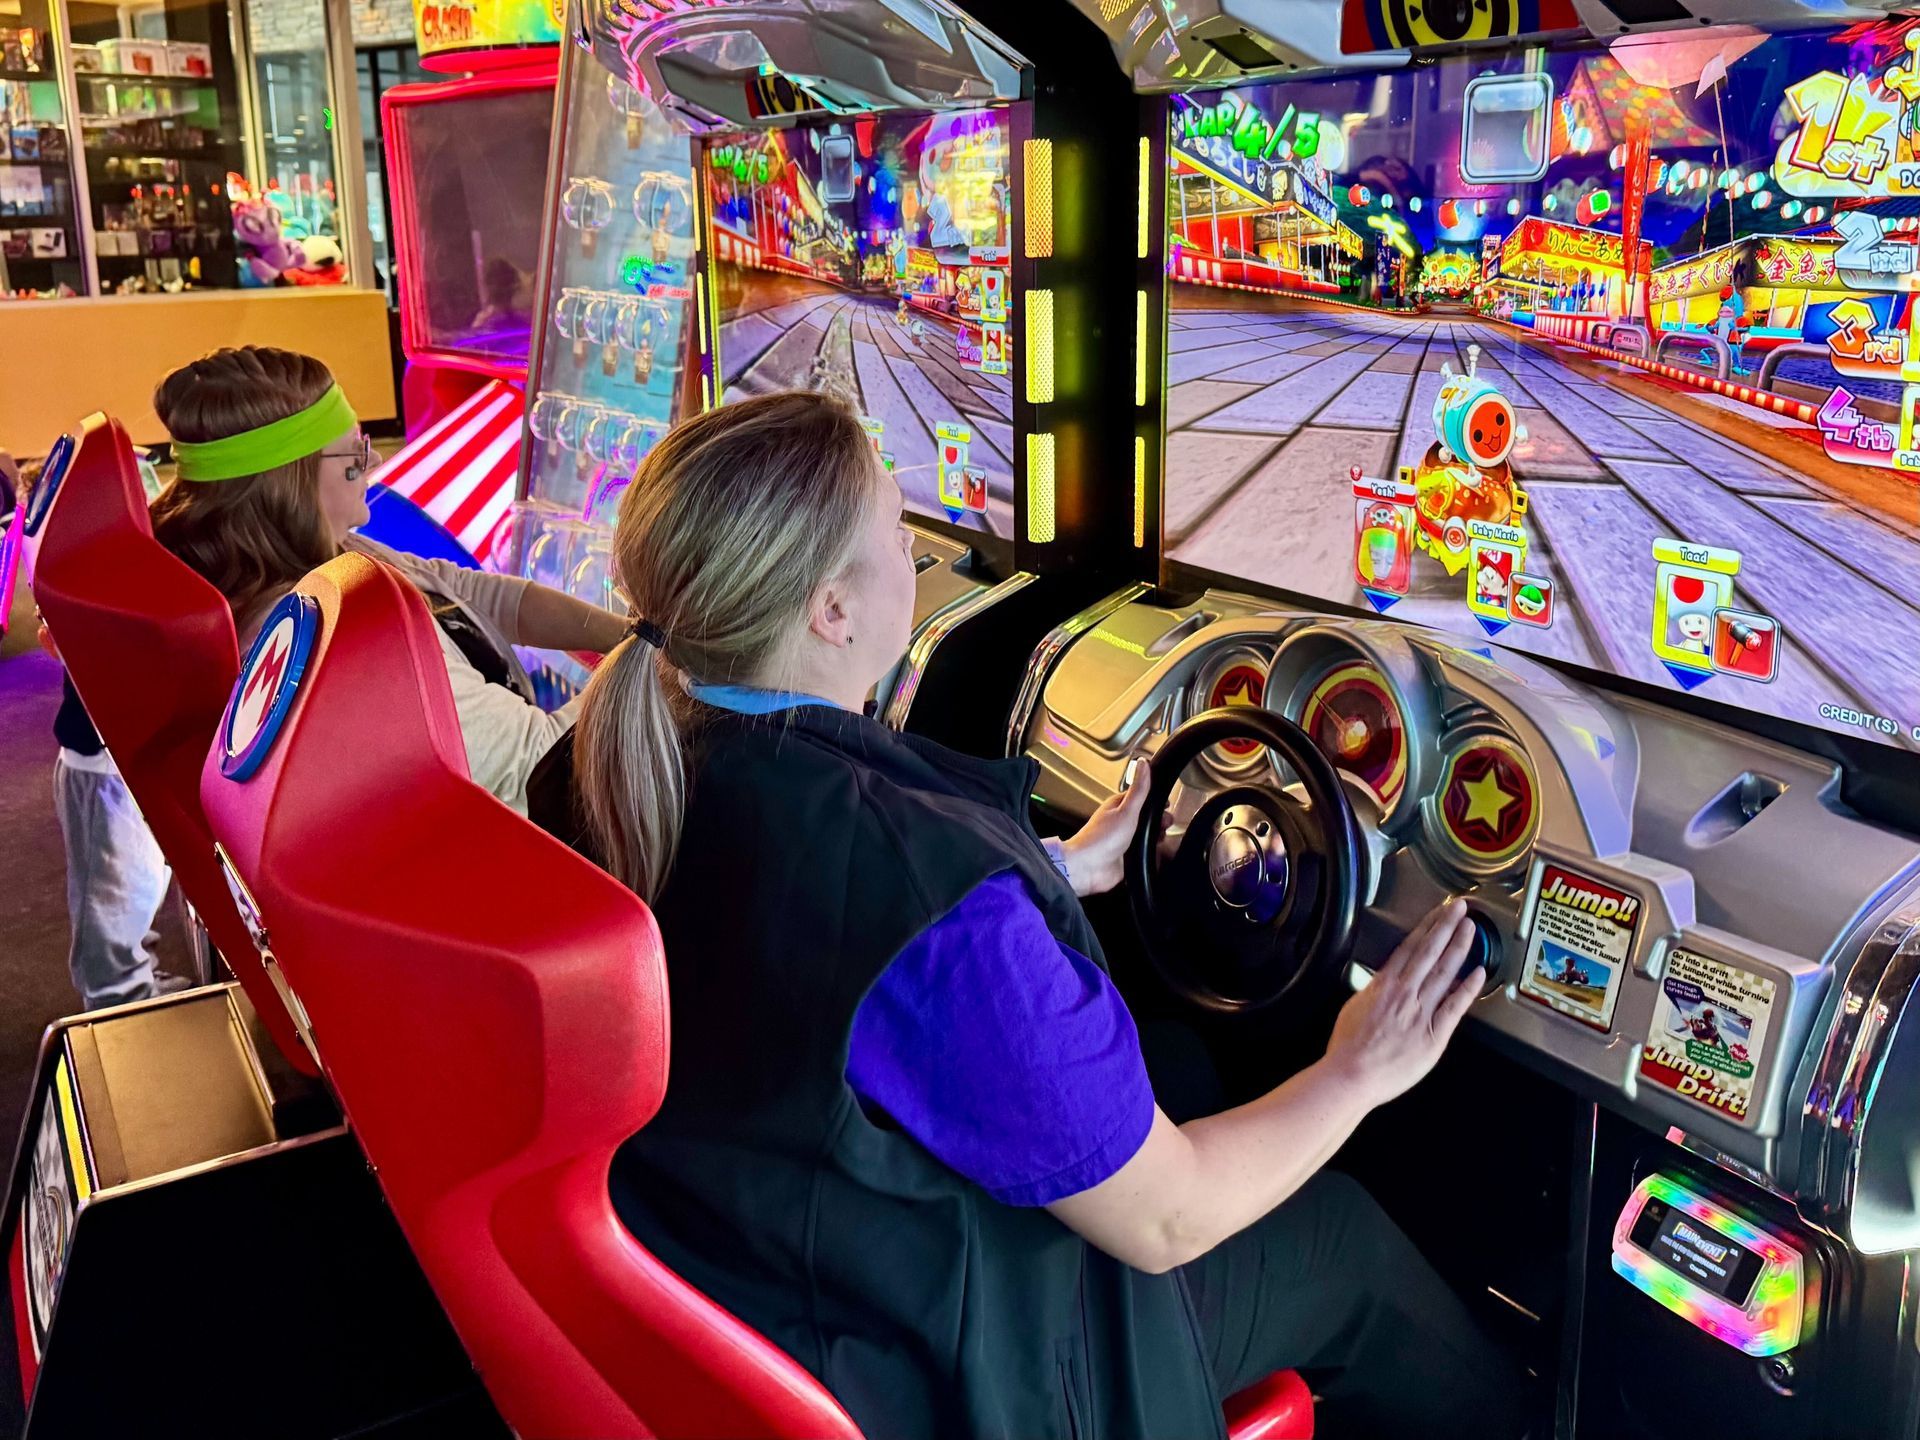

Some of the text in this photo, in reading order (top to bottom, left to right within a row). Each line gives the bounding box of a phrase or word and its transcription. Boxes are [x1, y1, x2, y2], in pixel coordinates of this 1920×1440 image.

[1183, 101, 1321, 160] LAP 4/5
[1784, 70, 1889, 185] 1st
[711, 144, 769, 184] LAP 4/5
[1834, 211, 1912, 273] 2nd
[1827, 298, 1903, 364] 3rd
[1816, 385, 1893, 450] 4th
[1371, 482, 1396, 498] Yoshi
[1472, 523, 1519, 542] Baby Mario
[1679, 546, 1709, 565] Toad
[1819, 702, 1899, 735] CREDIT(S)
[1540, 876, 1638, 922] Jump!!
[1538, 918, 1606, 949] on the accelerator
[1540, 911, 1595, 937] pressing down
[1543, 902, 1616, 937] Tap the brake while
[1537, 925, 1621, 965] to make the kart jump!
[1669, 967, 1682, 976] the
[1683, 973, 1716, 991] steering
[1670, 958, 1770, 1004] by jumping while turning
[1672, 951, 1684, 960] Go
[1685, 955, 1701, 967] into
[1709, 967, 1729, 979] drift
[1643, 1045, 1714, 1081] Jump
[1676, 1075, 1750, 1116] Drift!
[1677, 1225, 1701, 1243] MAIN
[1694, 1238, 1725, 1258] EVENT
